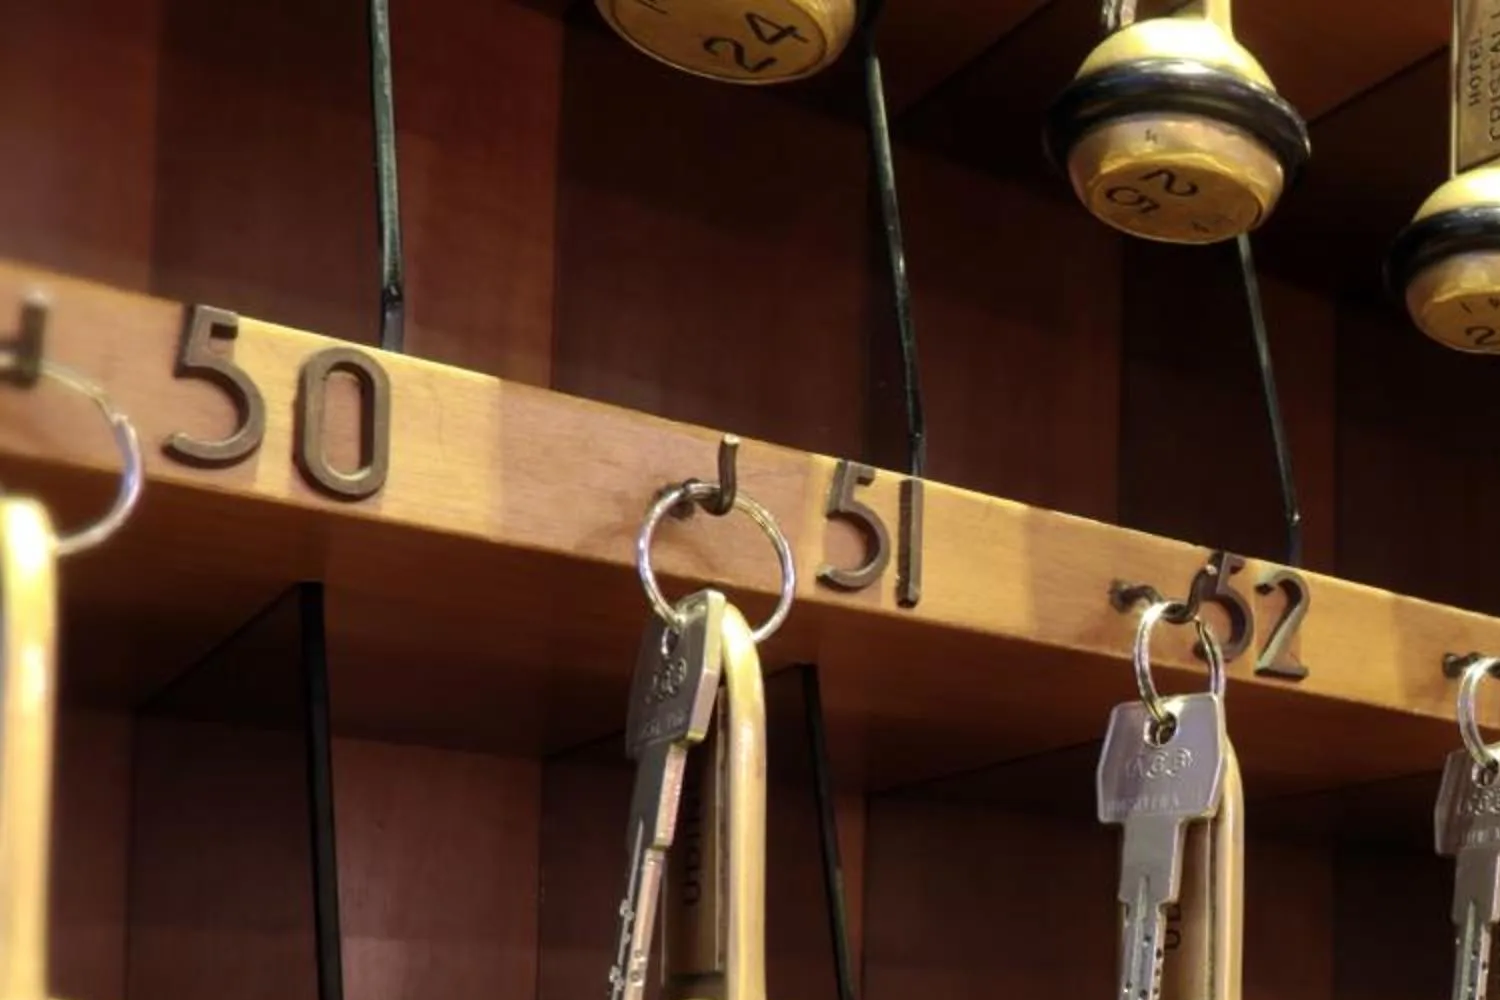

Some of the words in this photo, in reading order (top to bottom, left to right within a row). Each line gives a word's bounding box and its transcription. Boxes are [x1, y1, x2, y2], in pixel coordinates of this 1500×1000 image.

[703, 11, 809, 72] 24
[164, 304, 391, 499] 50
[818, 459, 924, 605] 51
[1193, 551, 1311, 682] 52
